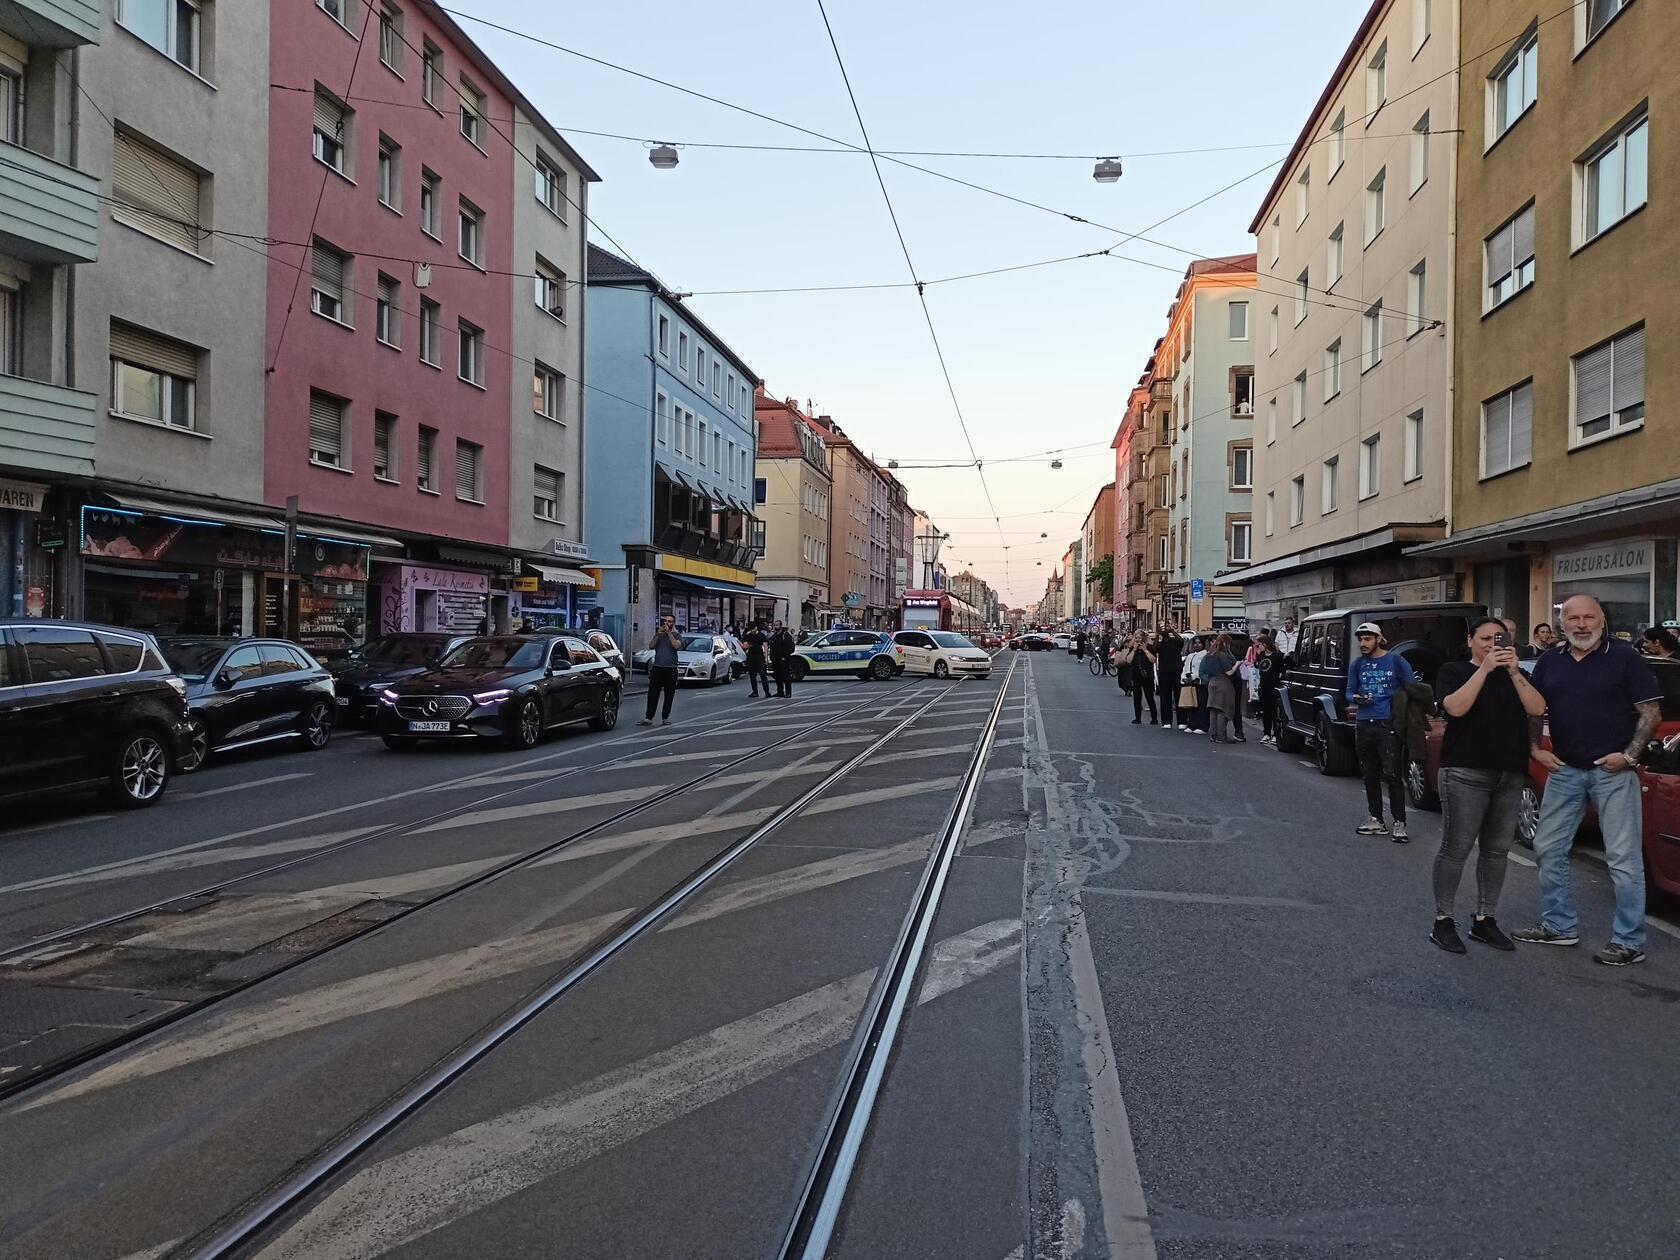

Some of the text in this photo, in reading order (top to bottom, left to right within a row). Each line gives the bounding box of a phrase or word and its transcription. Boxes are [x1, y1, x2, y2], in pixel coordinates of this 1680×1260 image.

[0, 489, 34, 507] AREN
[1557, 549, 1645, 574] FRISEURSALON
[817, 653, 840, 661] POLIZEI
